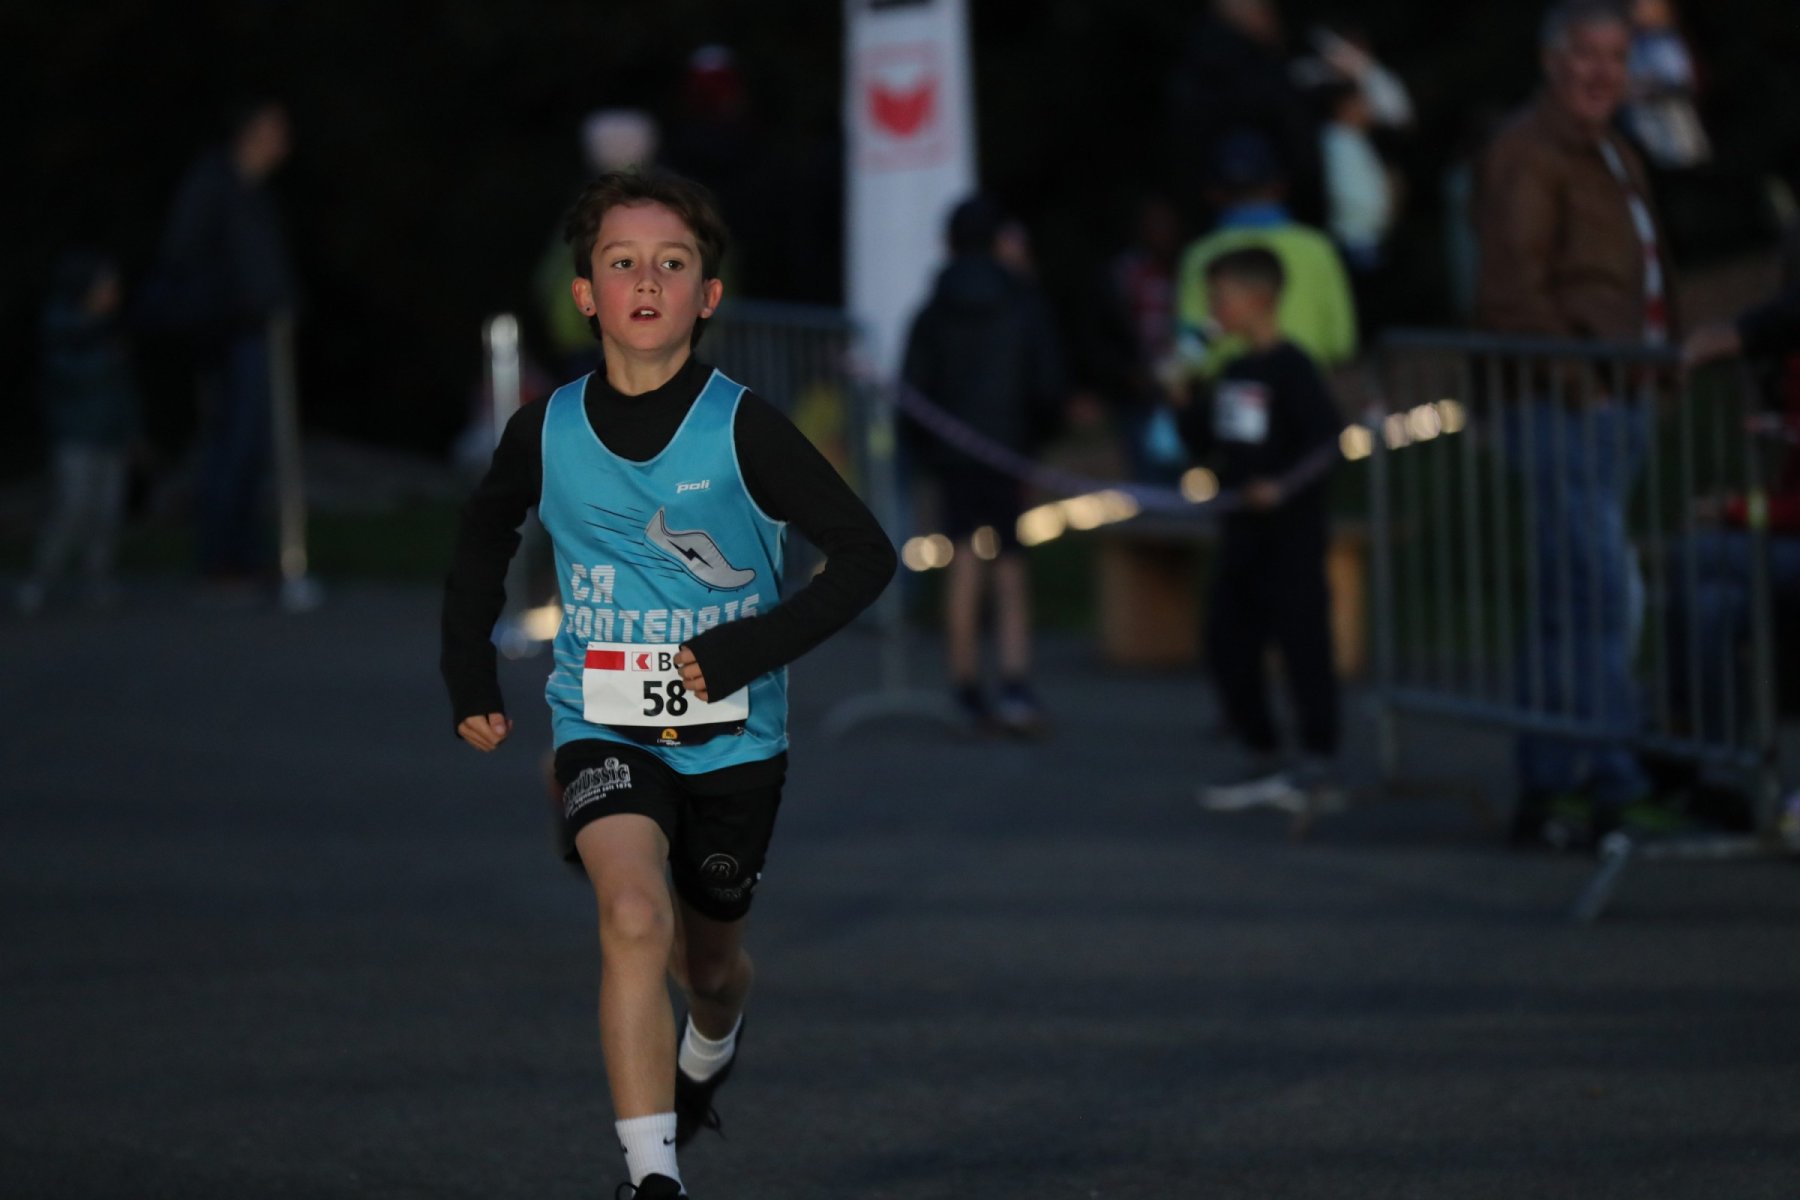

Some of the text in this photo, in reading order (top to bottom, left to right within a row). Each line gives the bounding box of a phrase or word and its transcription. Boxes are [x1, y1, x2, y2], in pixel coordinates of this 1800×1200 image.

[676, 480, 710, 494] poli
[571, 563, 616, 604] CA
[643, 680, 688, 716] 58
